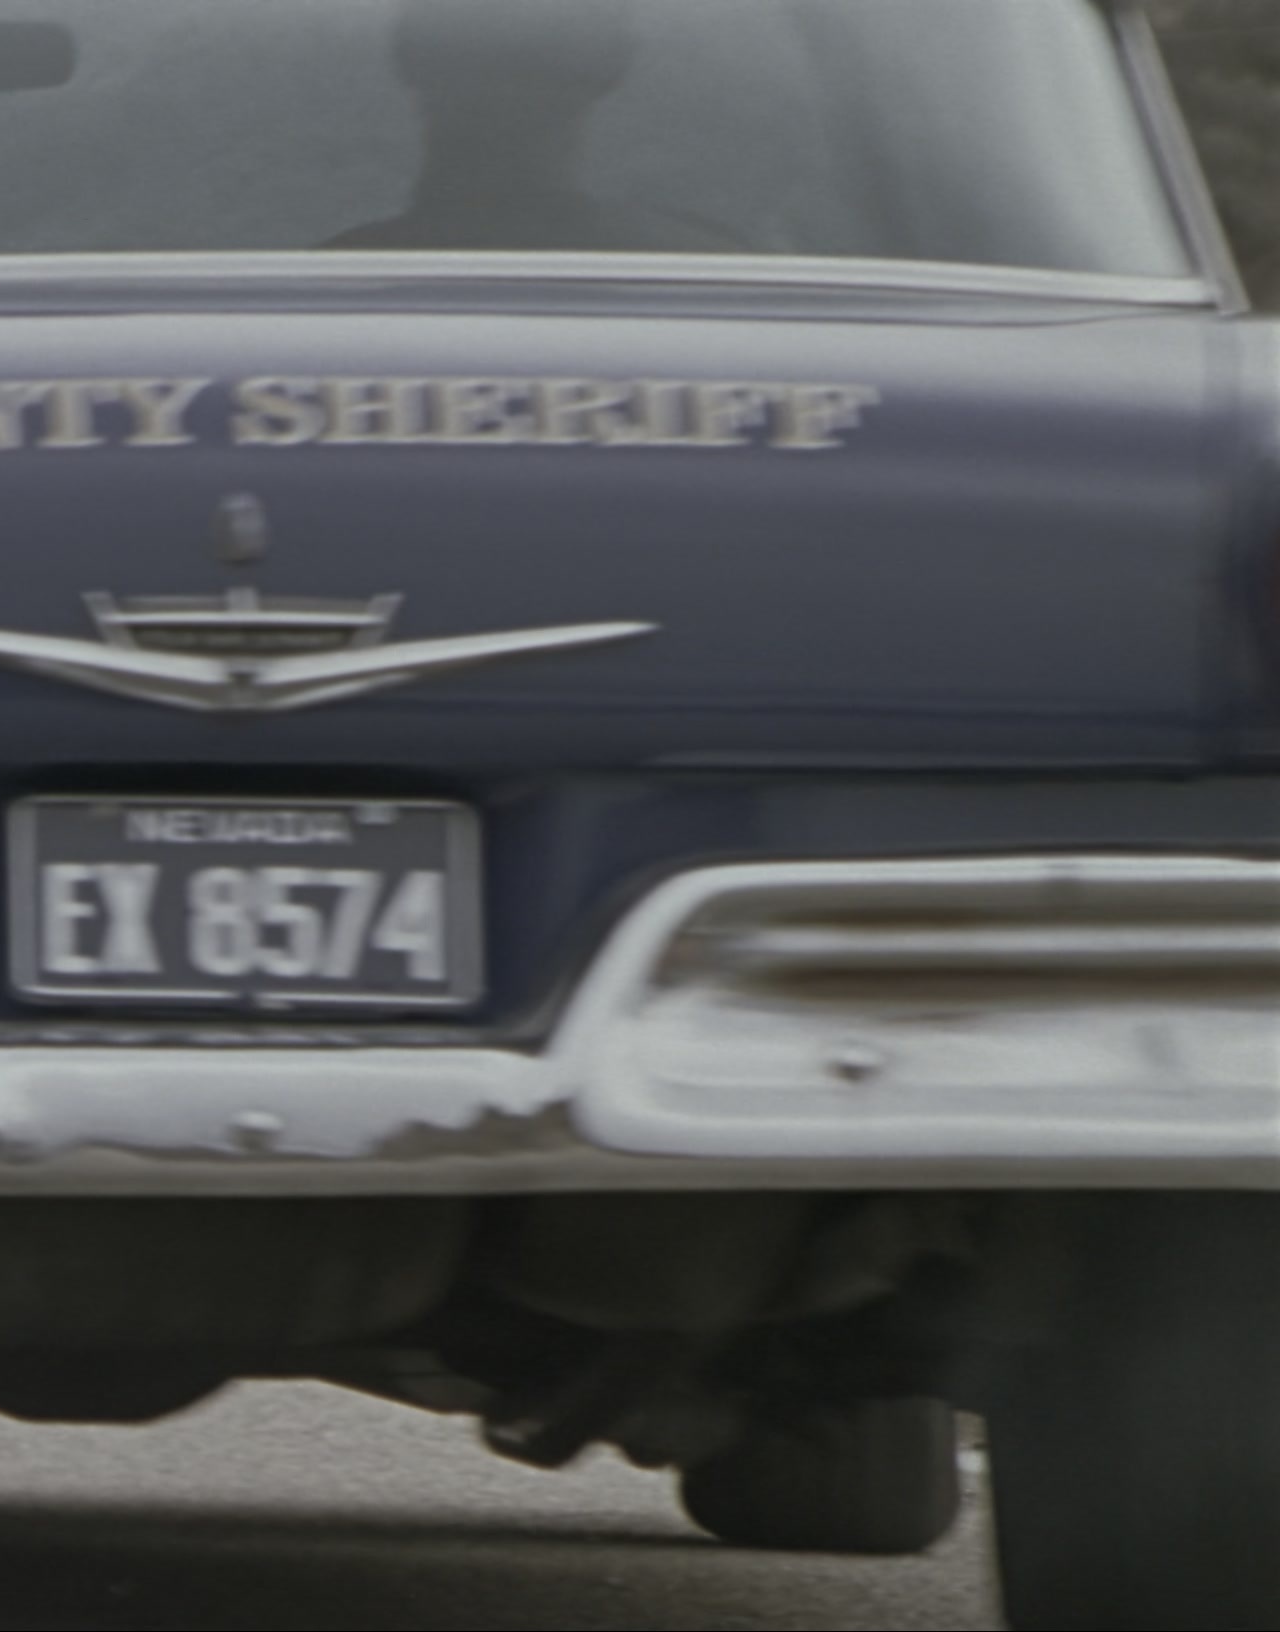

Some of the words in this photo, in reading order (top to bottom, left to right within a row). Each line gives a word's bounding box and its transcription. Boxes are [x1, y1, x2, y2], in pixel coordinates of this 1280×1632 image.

[230, 376, 878, 450] SHERIFF
[126, 809, 352, 843] NEVADA
[41, 863, 162, 974] EX
[187, 866, 446, 981] 8574
